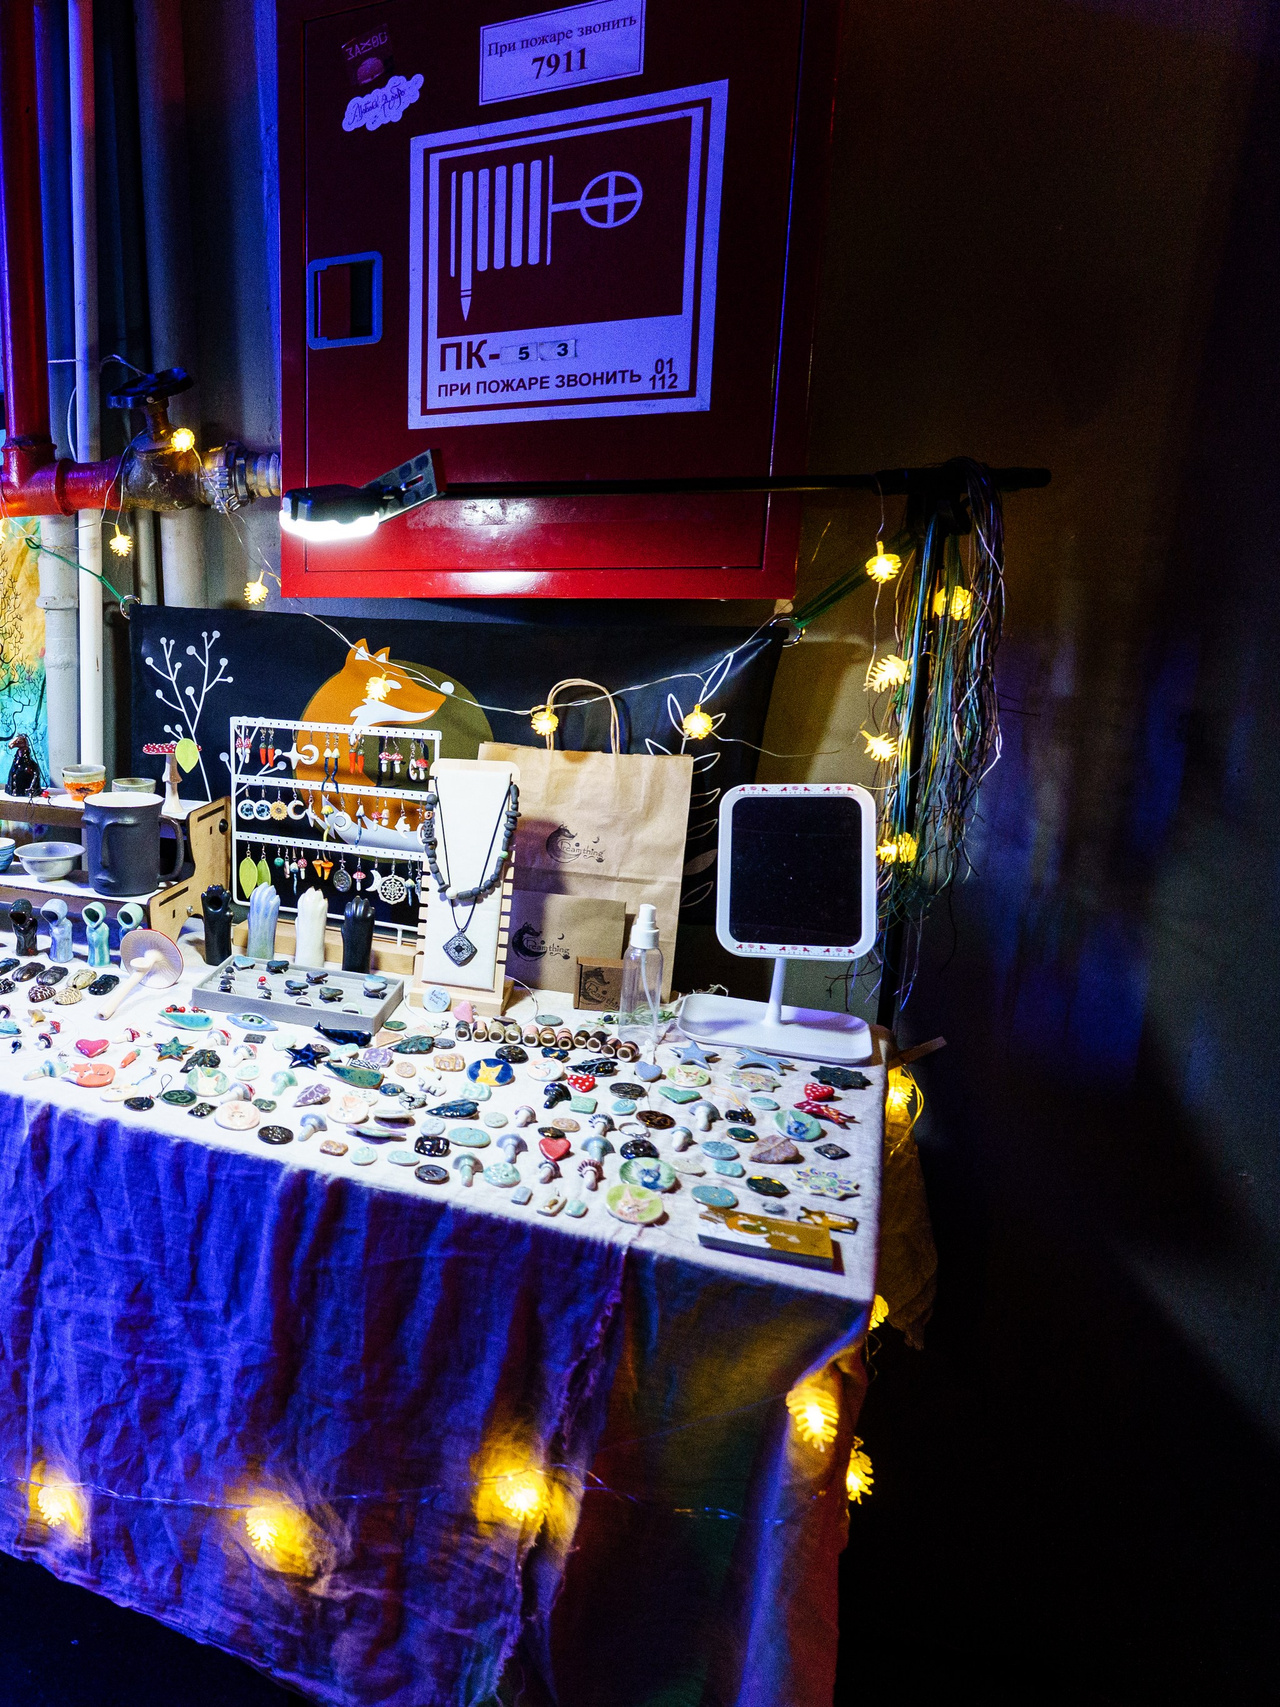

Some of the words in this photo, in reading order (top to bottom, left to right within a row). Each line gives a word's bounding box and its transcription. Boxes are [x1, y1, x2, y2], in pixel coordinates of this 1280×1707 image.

[487, 41, 516, 57] При
[521, 28, 573, 49] пожаре
[577, 15, 637, 37] звонить
[531, 47, 588, 79] 7911
[654, 357, 674, 375] 01
[438, 383, 471, 398] ПРИ
[476, 376, 550, 395] ПОЖАРЕ
[555, 369, 642, 388] ЗВОНИТЬ
[649, 373, 678, 391] 112
